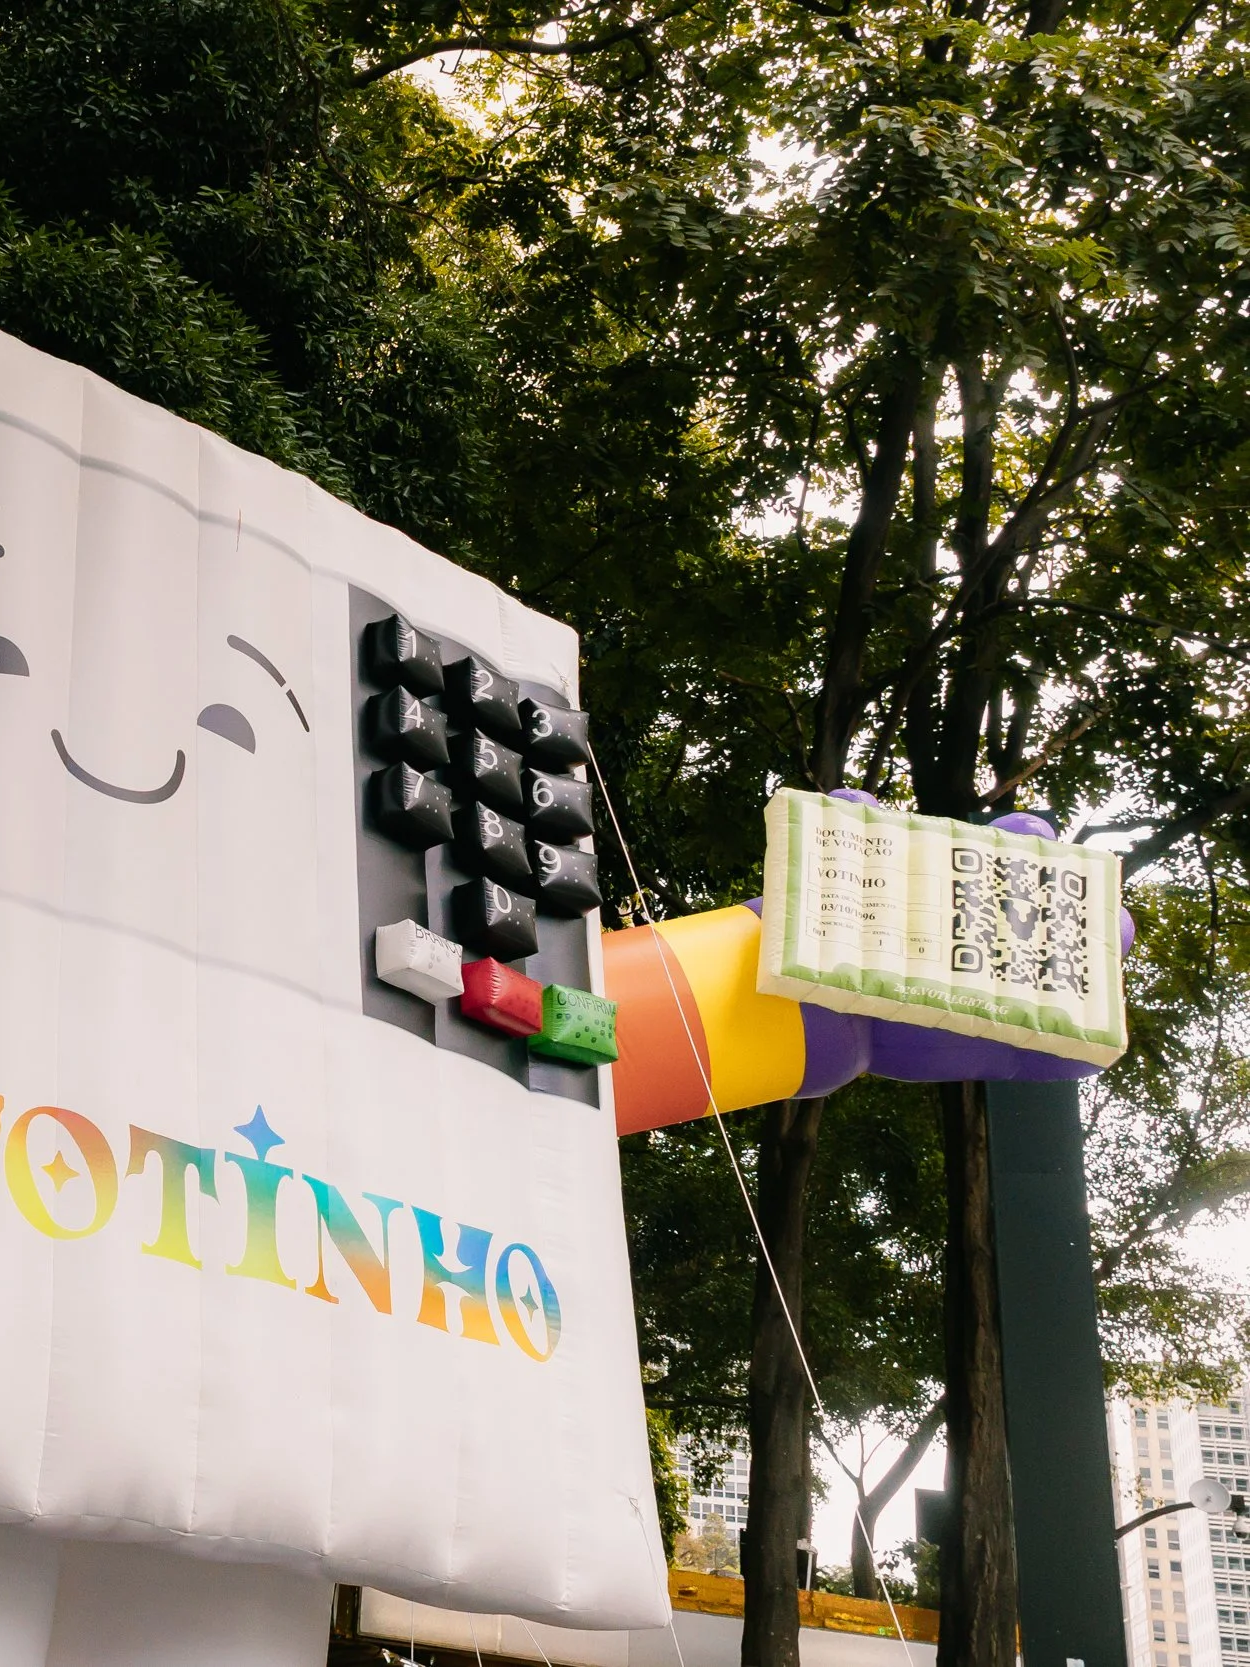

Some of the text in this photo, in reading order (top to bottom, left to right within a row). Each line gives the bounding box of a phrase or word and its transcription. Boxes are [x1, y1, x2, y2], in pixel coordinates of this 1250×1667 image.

[405, 629, 417, 658] 1
[472, 669, 494, 701] 2
[403, 699, 425, 728] 4
[531, 708, 553, 738] 3
[477, 738, 498, 769] 5
[406, 768, 425, 799] 7
[532, 777, 554, 807] 6
[482, 808, 504, 838] 8
[815, 827, 893, 847] DOCUMENTO
[538, 844, 562, 874] 9
[815, 836, 892, 857] DE VOTAÇÃO
[817, 867, 886, 888] VOTINHO
[492, 884, 513, 914] 0
